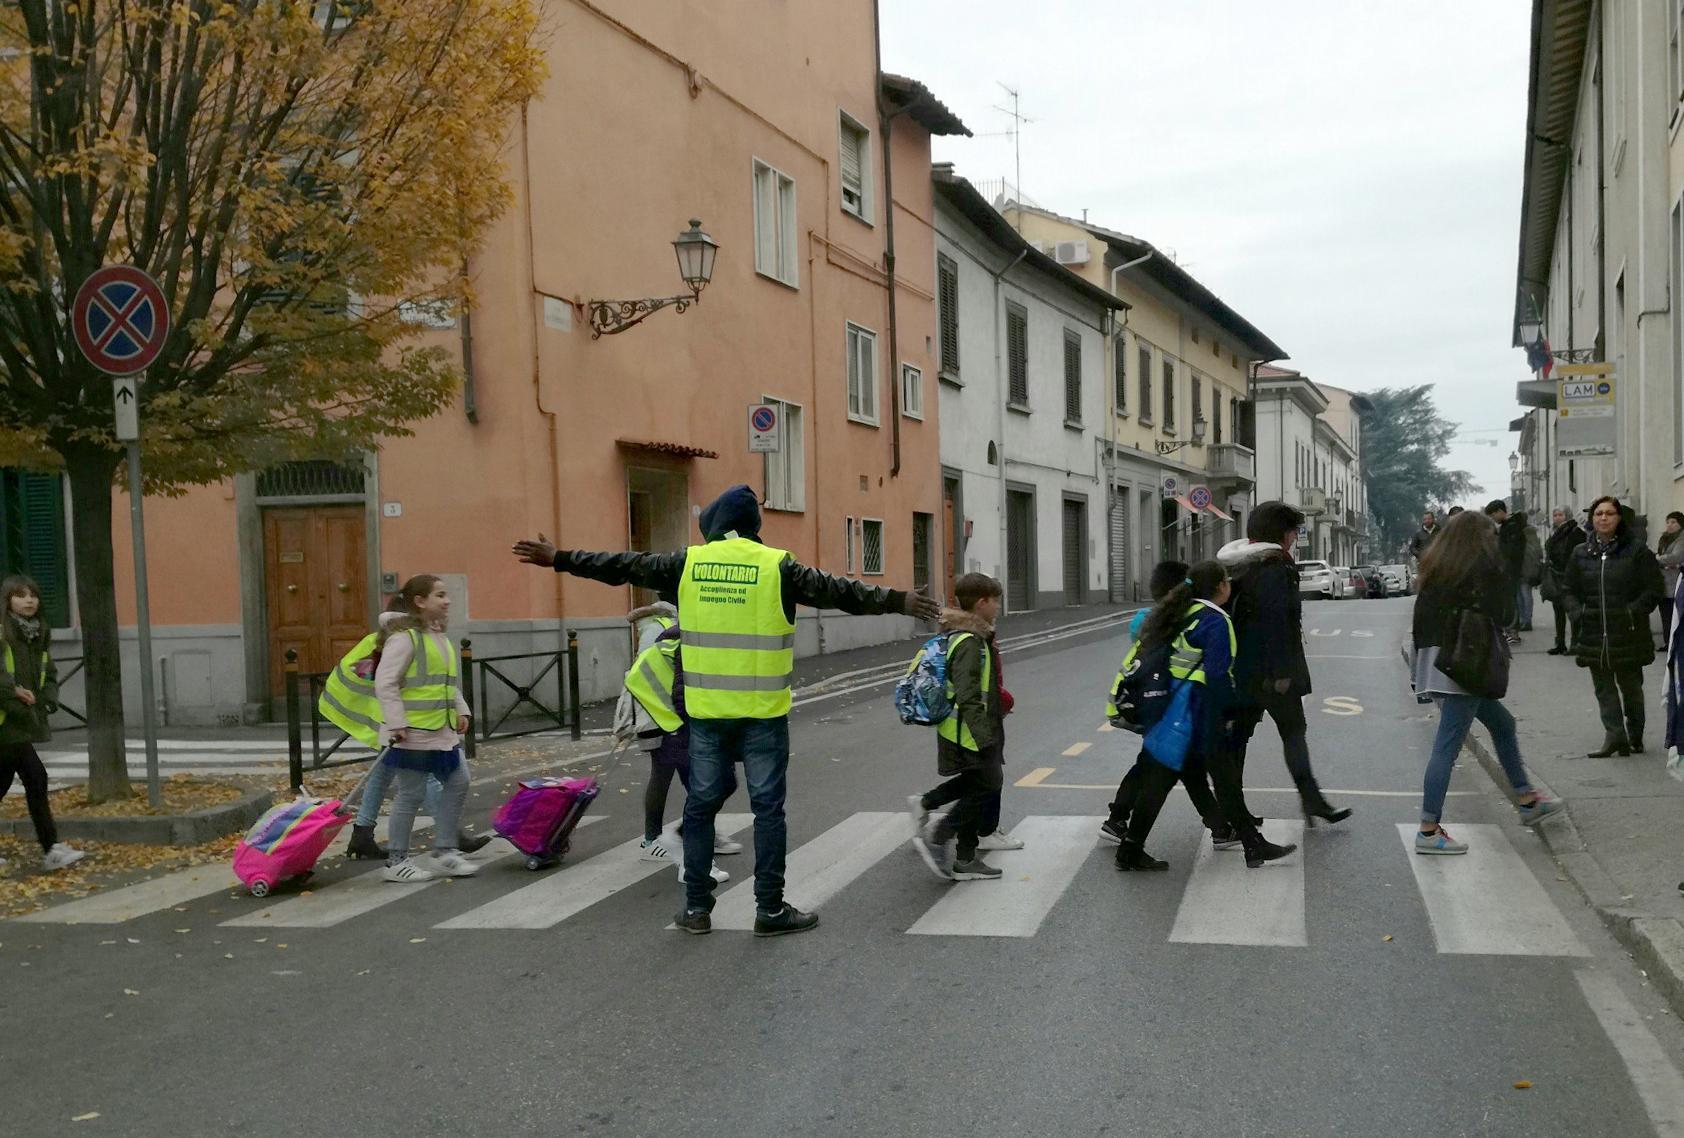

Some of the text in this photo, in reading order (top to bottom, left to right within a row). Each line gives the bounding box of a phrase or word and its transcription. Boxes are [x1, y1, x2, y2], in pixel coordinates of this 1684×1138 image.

[1564, 384, 1593, 396] LAM
[694, 563, 757, 583] VOLONTARIO
[700, 585, 737, 594] Accoglienza
[699, 595, 746, 604] Impegno Civile
[1309, 628, 1375, 637] US
